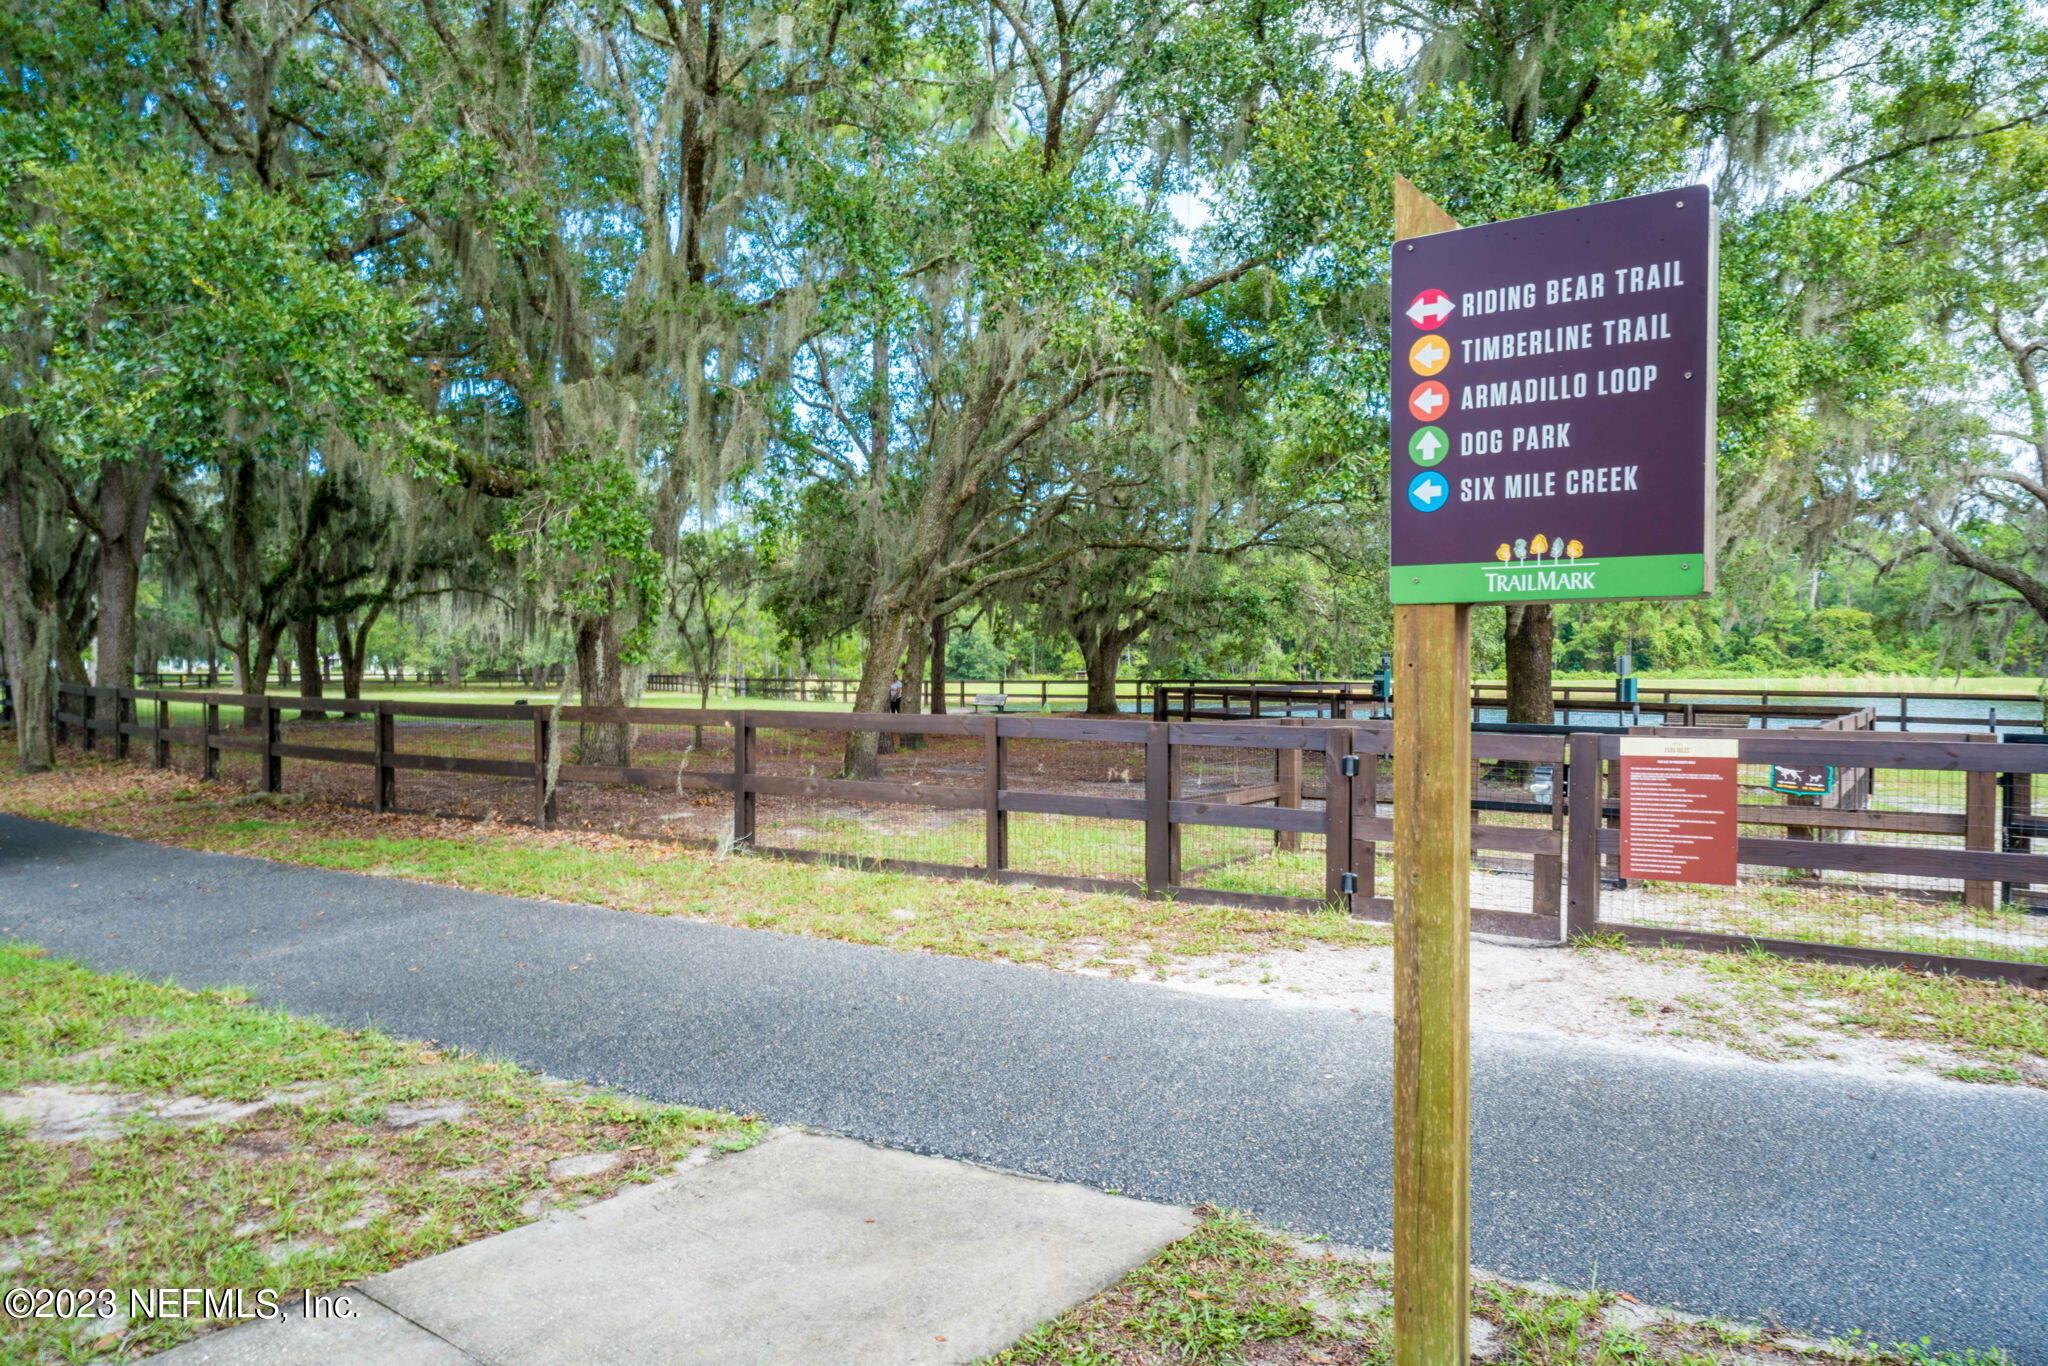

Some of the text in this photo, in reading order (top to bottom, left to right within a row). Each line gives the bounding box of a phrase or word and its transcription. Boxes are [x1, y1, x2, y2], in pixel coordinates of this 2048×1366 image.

[1462, 260, 1684, 318] RIDING BEAR TRAIL
[1462, 313, 1671, 364] TIMBERLINE TRAIL
[1461, 365, 1657, 410] ARMADILLO LOOP
[1460, 423, 1570, 456] DOG PARK
[1460, 465, 1638, 502] SIX MILE CREEK
